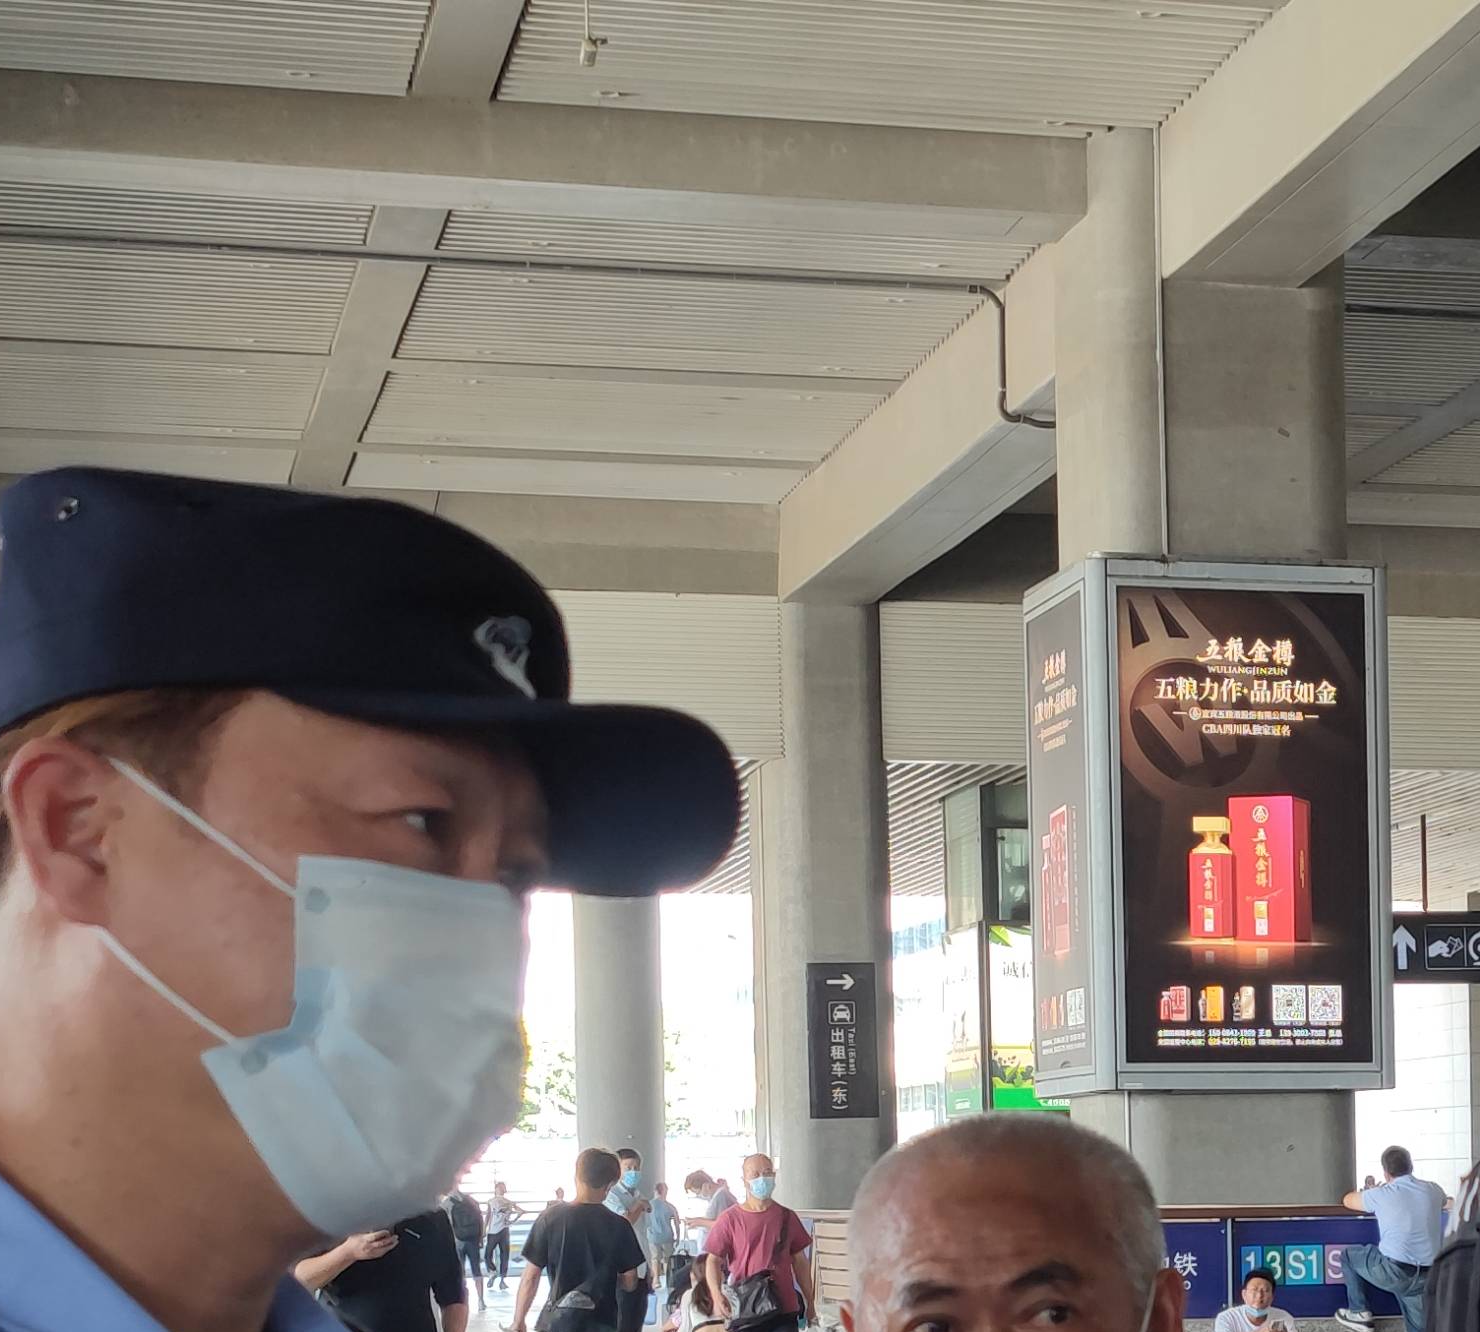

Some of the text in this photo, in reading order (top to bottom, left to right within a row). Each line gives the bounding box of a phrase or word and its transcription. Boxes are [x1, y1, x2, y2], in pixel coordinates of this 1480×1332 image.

[1196, 637, 1294, 667] 五粮金樽
[1289, 1251, 1318, 1279] S1
